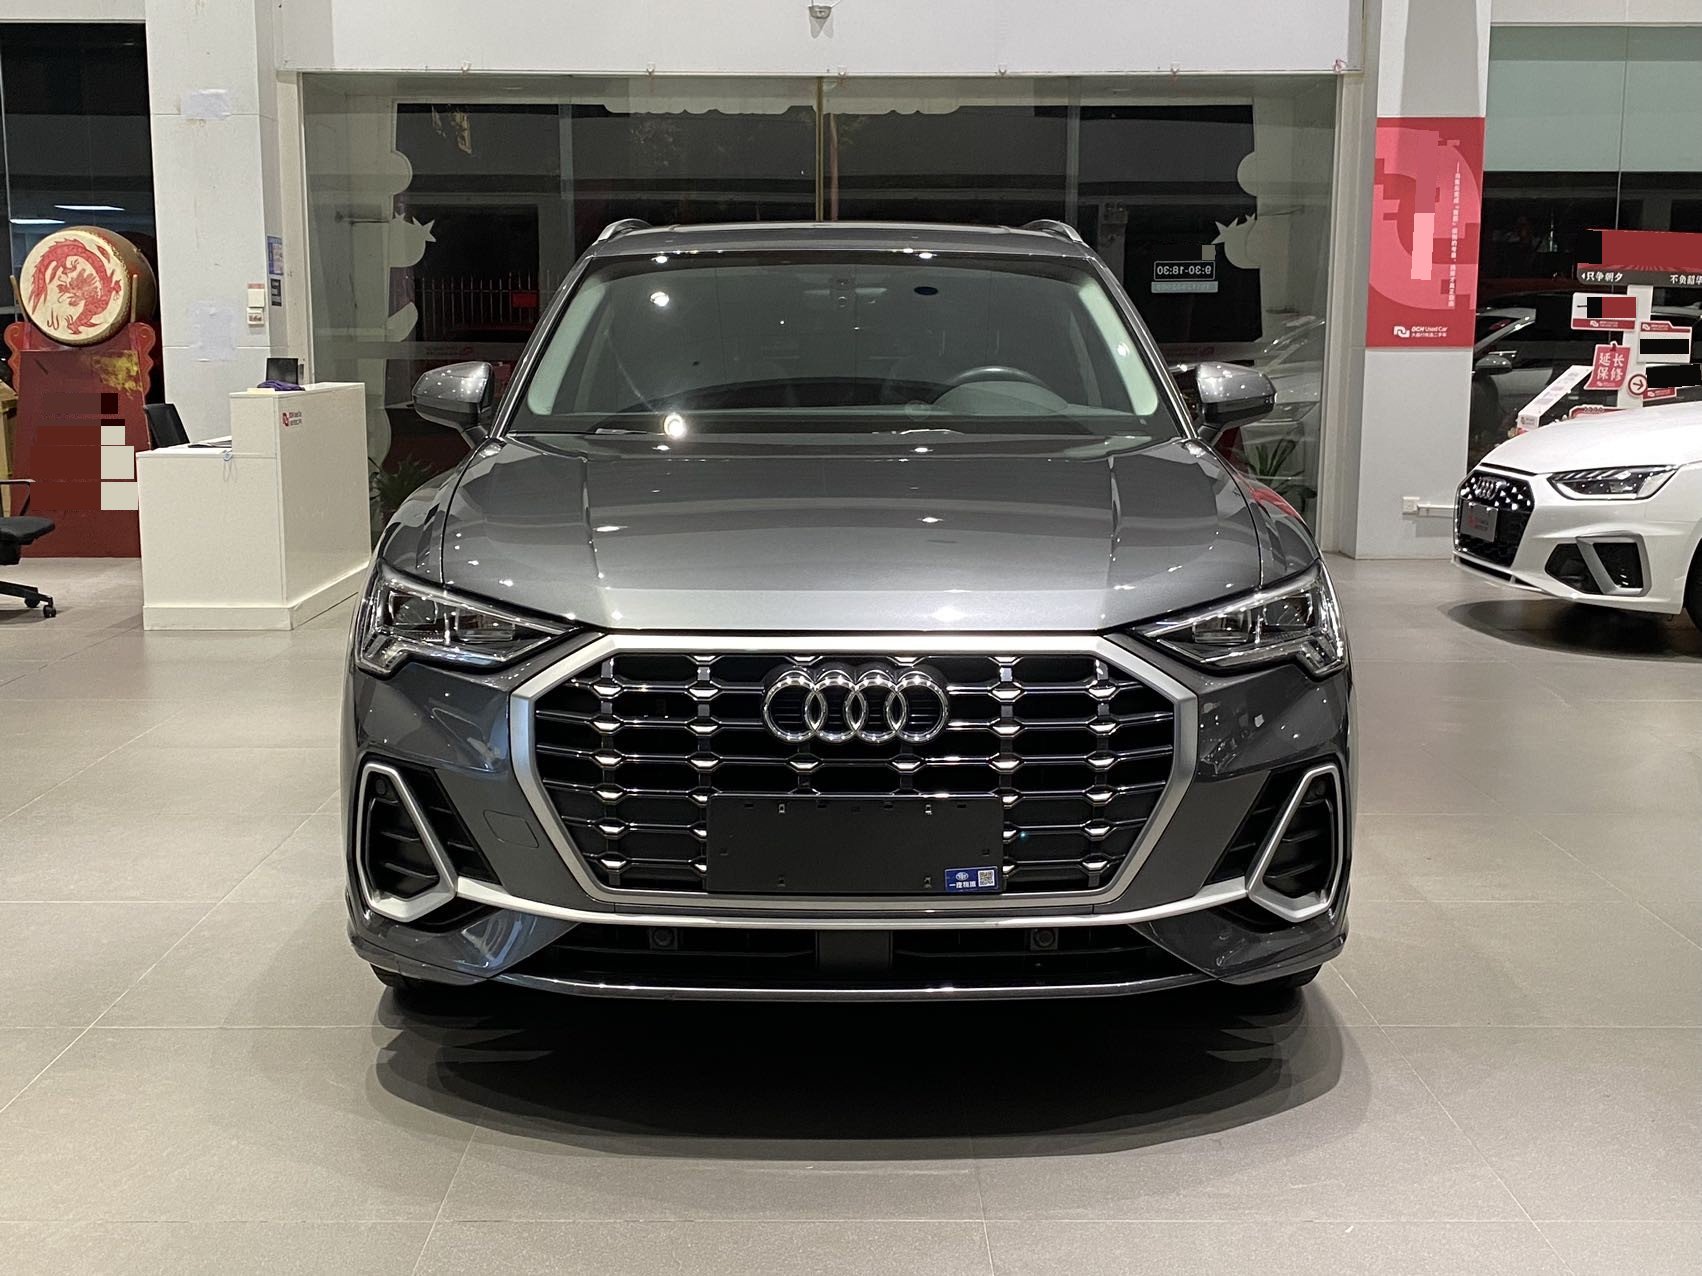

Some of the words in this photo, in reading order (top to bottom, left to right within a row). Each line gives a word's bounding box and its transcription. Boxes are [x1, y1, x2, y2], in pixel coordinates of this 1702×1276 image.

[1586, 271, 1623, 282] 只争朝夕
[1599, 352, 1625, 366] 延长
[1597, 368, 1623, 381] 保修
